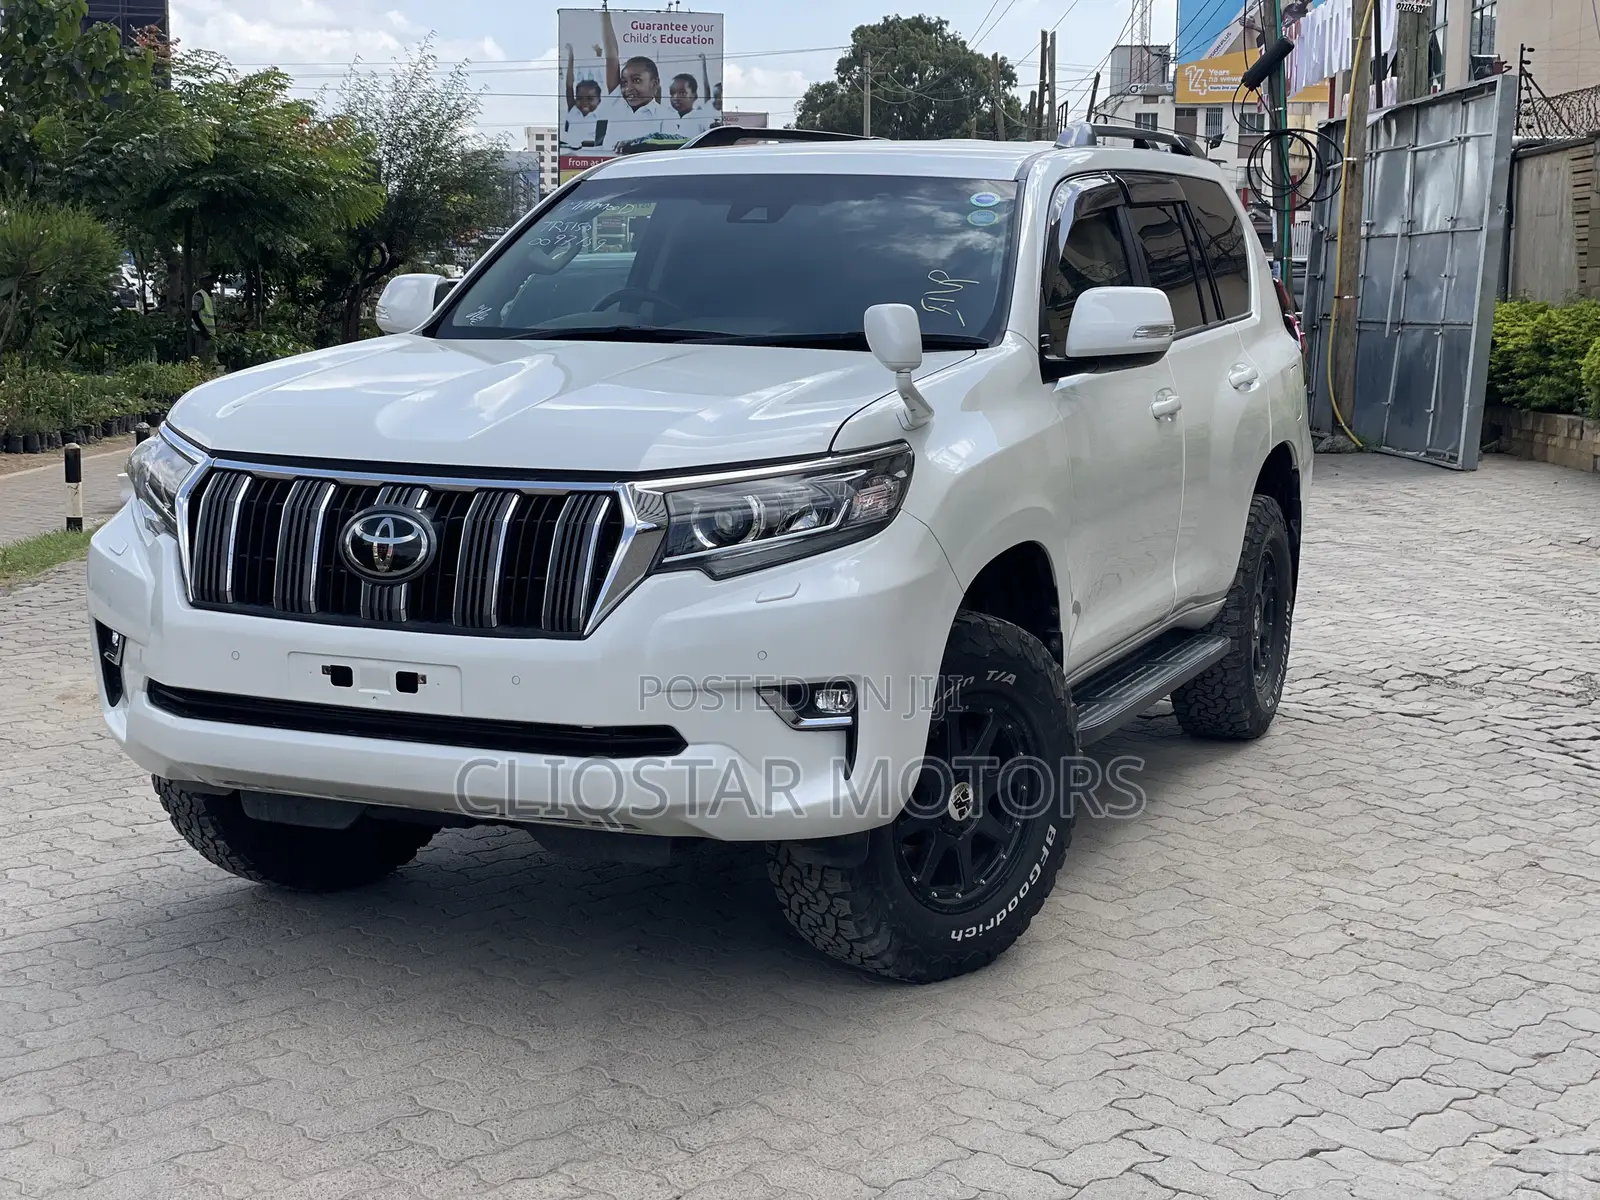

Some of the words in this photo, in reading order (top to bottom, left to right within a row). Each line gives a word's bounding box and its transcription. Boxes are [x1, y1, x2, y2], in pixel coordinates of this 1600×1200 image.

[630, 20, 688, 31] Guarantee
[690, 24, 715, 33] your
[622, 33, 657, 43] Child's
[660, 34, 714, 45] Education
[1208, 68, 1230, 76] Years
[1184, 65, 1208, 96] 14
[568, 158, 588, 167] from
[590, 160, 600, 168] as
[985, 670, 1017, 686] T/A
[950, 823, 1057, 942] BFGoodrich
